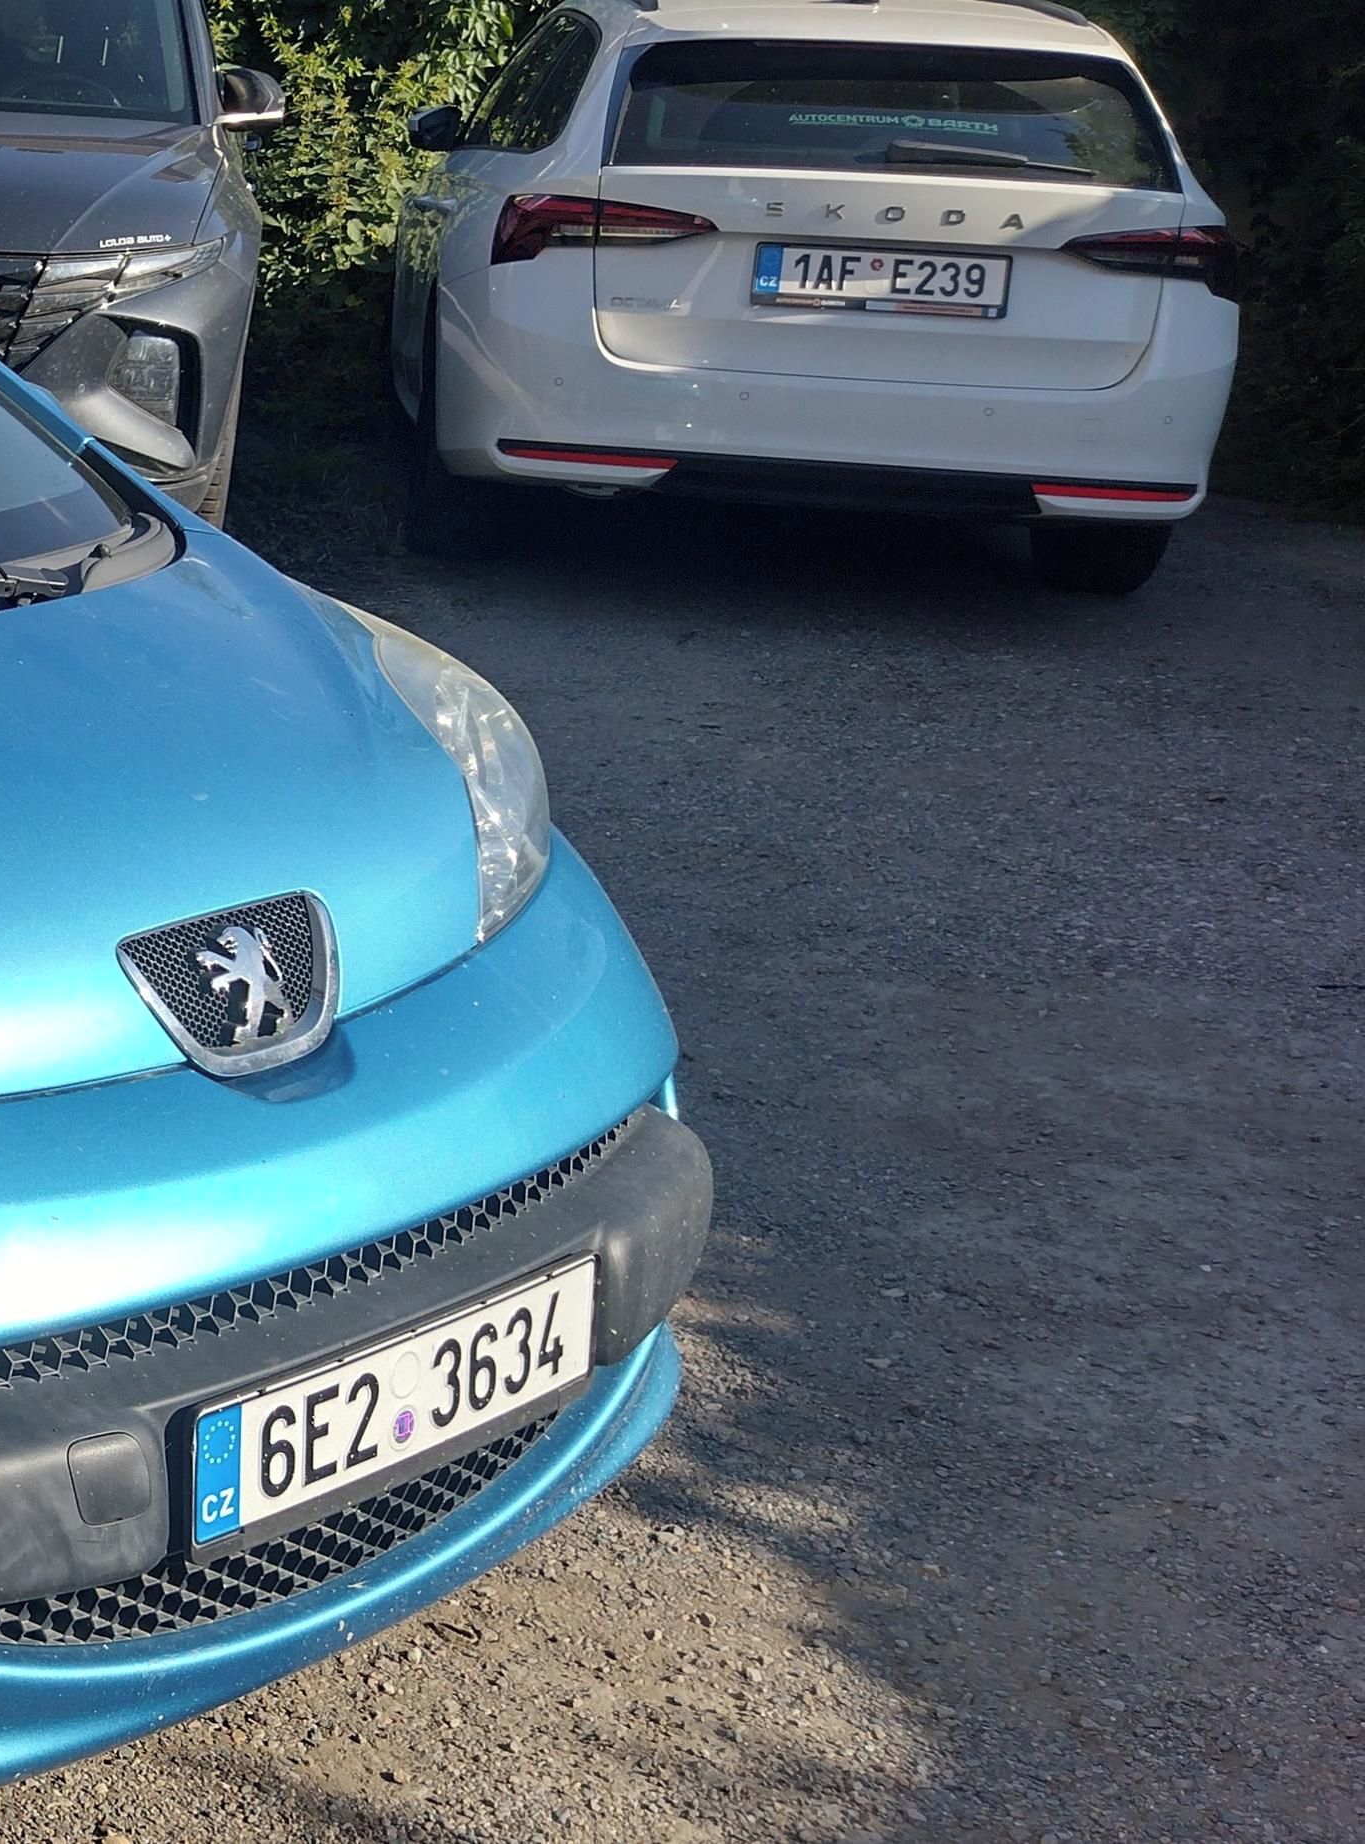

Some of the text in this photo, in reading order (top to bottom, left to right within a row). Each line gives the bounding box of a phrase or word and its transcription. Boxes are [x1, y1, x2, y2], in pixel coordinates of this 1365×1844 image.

[789, 112, 998, 132] AUTOCENTRUM BARTH
[760, 275, 777, 287] CZ
[794, 254, 986, 298] 1AF E239
[259, 1291, 564, 1498] 6E2 3634
[201, 1487, 235, 1525] CZ
